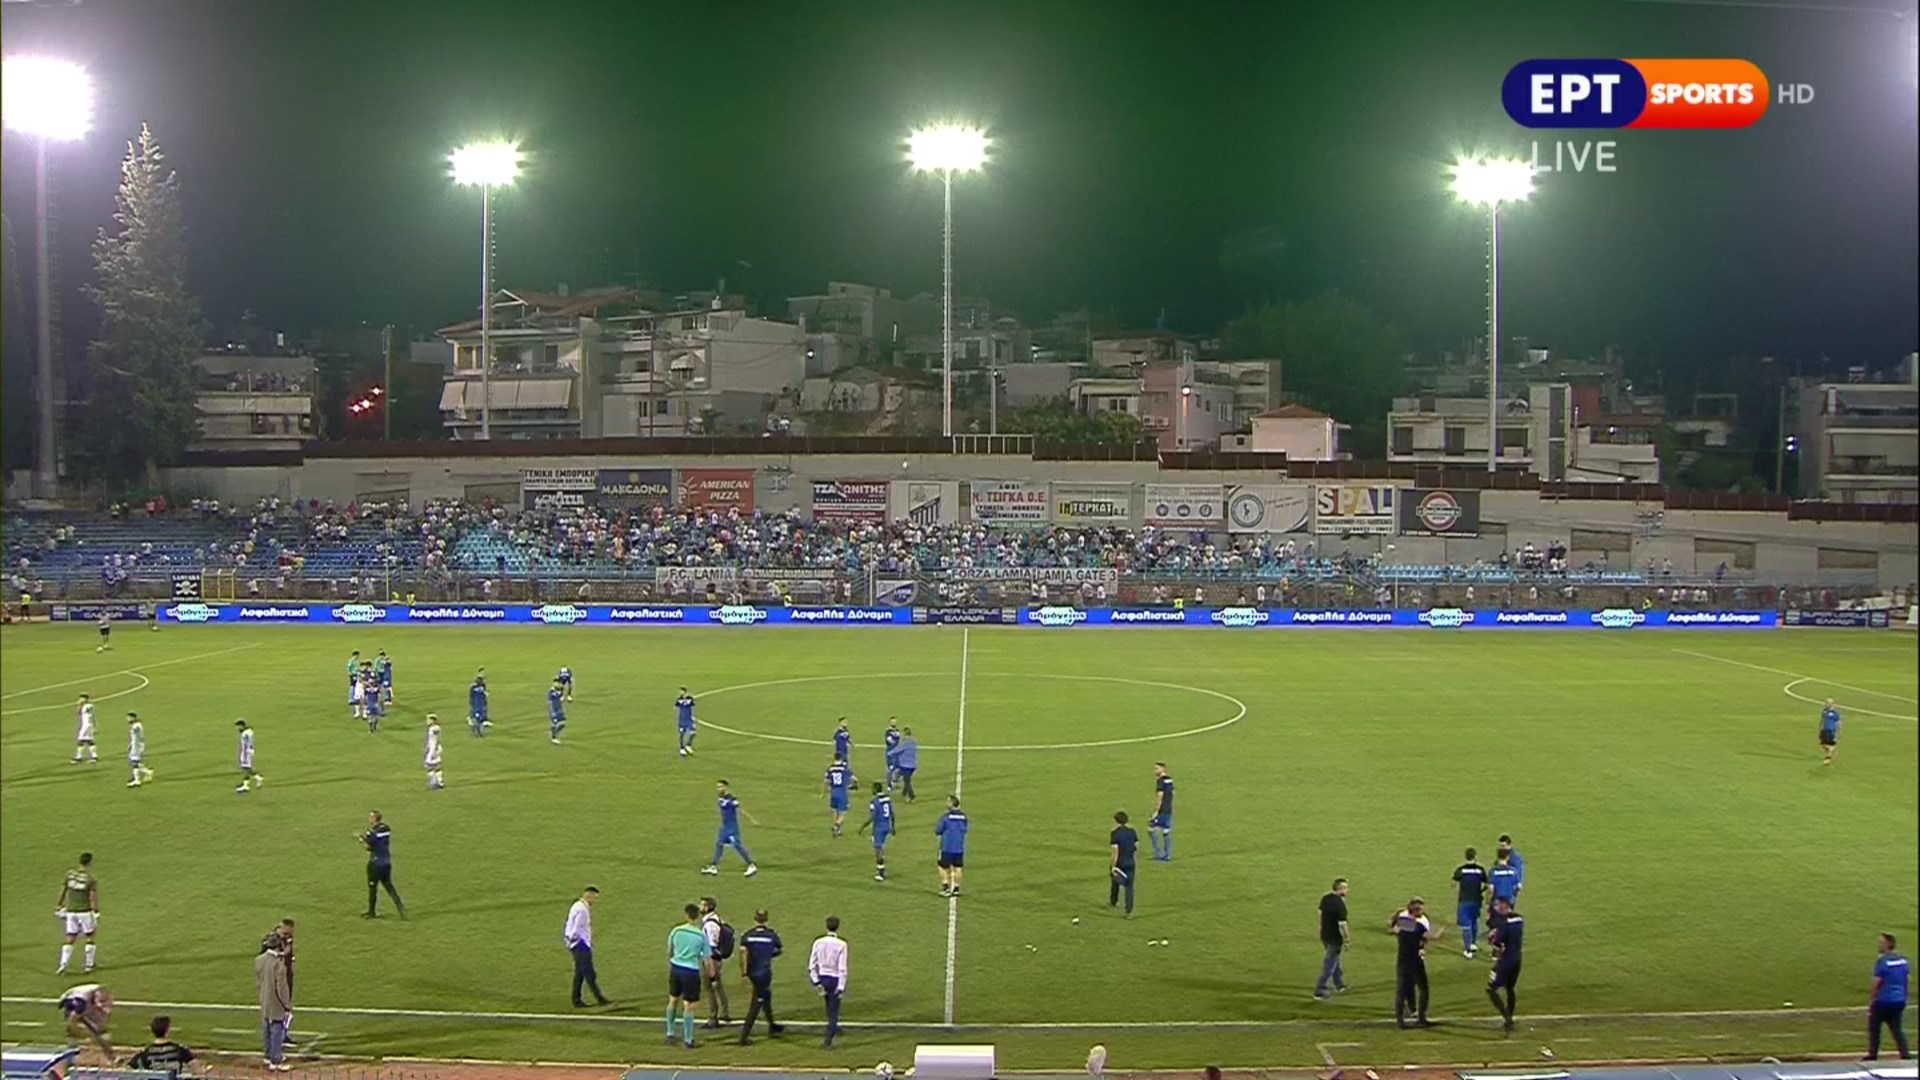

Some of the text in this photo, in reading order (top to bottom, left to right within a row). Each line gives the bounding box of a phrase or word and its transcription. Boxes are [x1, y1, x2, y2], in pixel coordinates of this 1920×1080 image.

[700, 480, 750, 489] AMERICAN
[710, 491, 740, 500] PIZZA
[1318, 487, 1393, 515] SPAL
[695, 568, 732, 580] LAMIA
[951, 569, 1032, 579] FORZA LAMIA
[1037, 569, 1117, 582] LAMIA GATE 3
[847, 609, 892, 621] Δύναμη
[883, 803, 889, 817] 9
